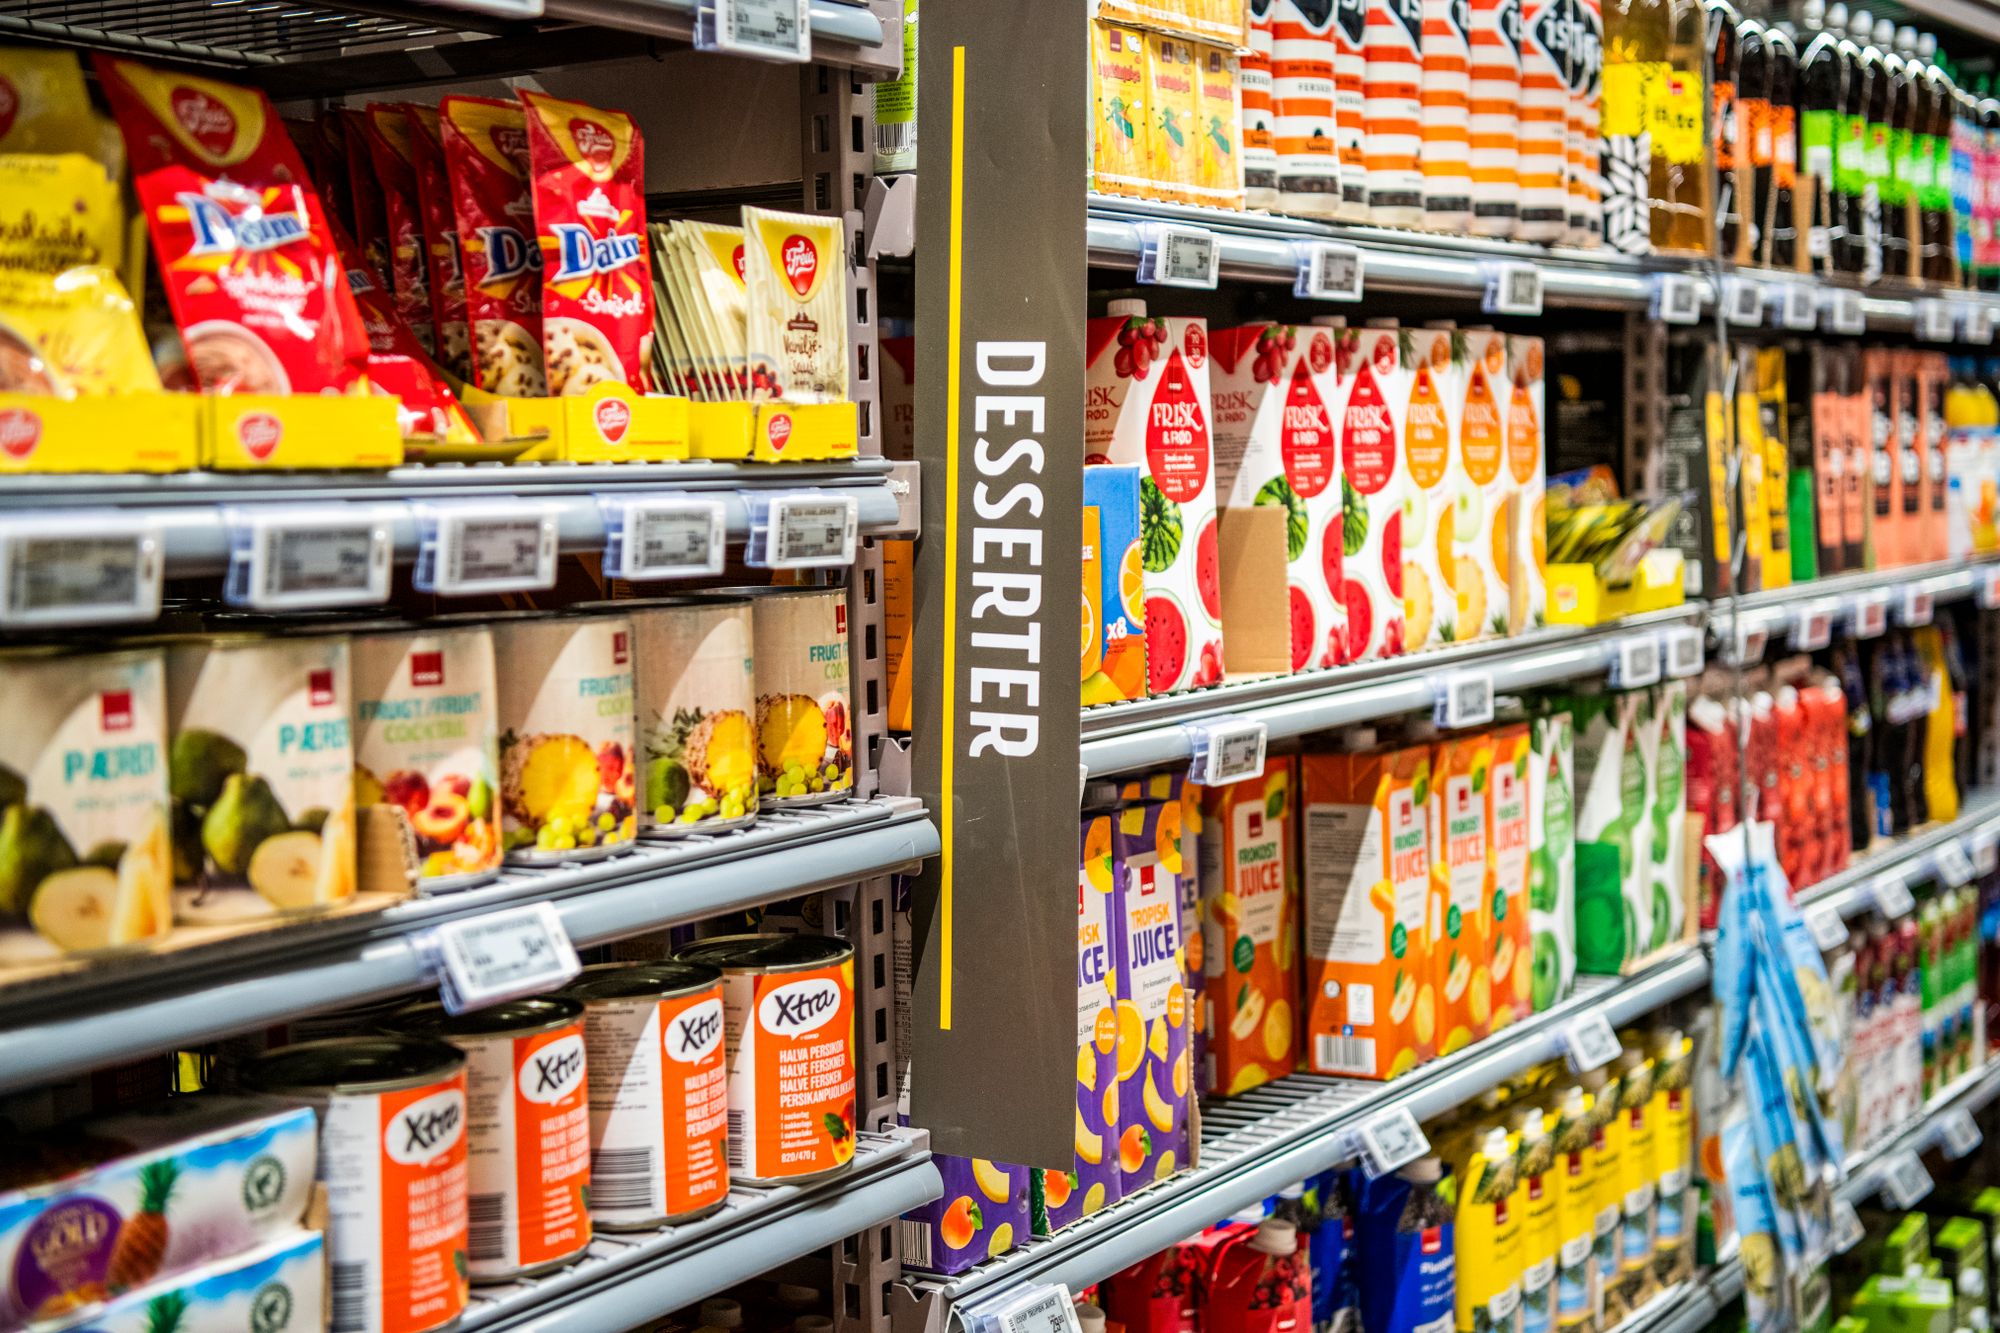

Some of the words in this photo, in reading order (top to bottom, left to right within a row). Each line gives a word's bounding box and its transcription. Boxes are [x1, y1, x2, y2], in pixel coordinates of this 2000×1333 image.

[785, 240, 816, 277] Freia
[1086, 386, 1120, 408] ISK
[1153, 401, 1203, 432] FRISK
[1286, 405, 1329, 433] FRISK
[1170, 430, 1193, 446] RØD
[968, 341, 1046, 758] DESSERTER
[1239, 861, 1281, 898] JUICE
[1130, 902, 1170, 930] TROPISK
[1078, 923, 1101, 946] PISK
[1131, 924, 1176, 970] JUICE
[1078, 945, 1106, 988] ICE
[774, 989, 836, 1027] Xtra
[679, 1010, 722, 1054] Xtra
[780, 1047, 809, 1064] HALVA
[810, 1039, 845, 1059] PERSIKOR
[780, 1061, 809, 1078] HALVE
[810, 1053, 846, 1075] FERSKNER
[536, 1049, 580, 1094] Xtra
[780, 1076, 809, 1094] HALVE
[810, 1069, 843, 1090] FERSKEN
[781, 1150, 811, 1164] 820/470
